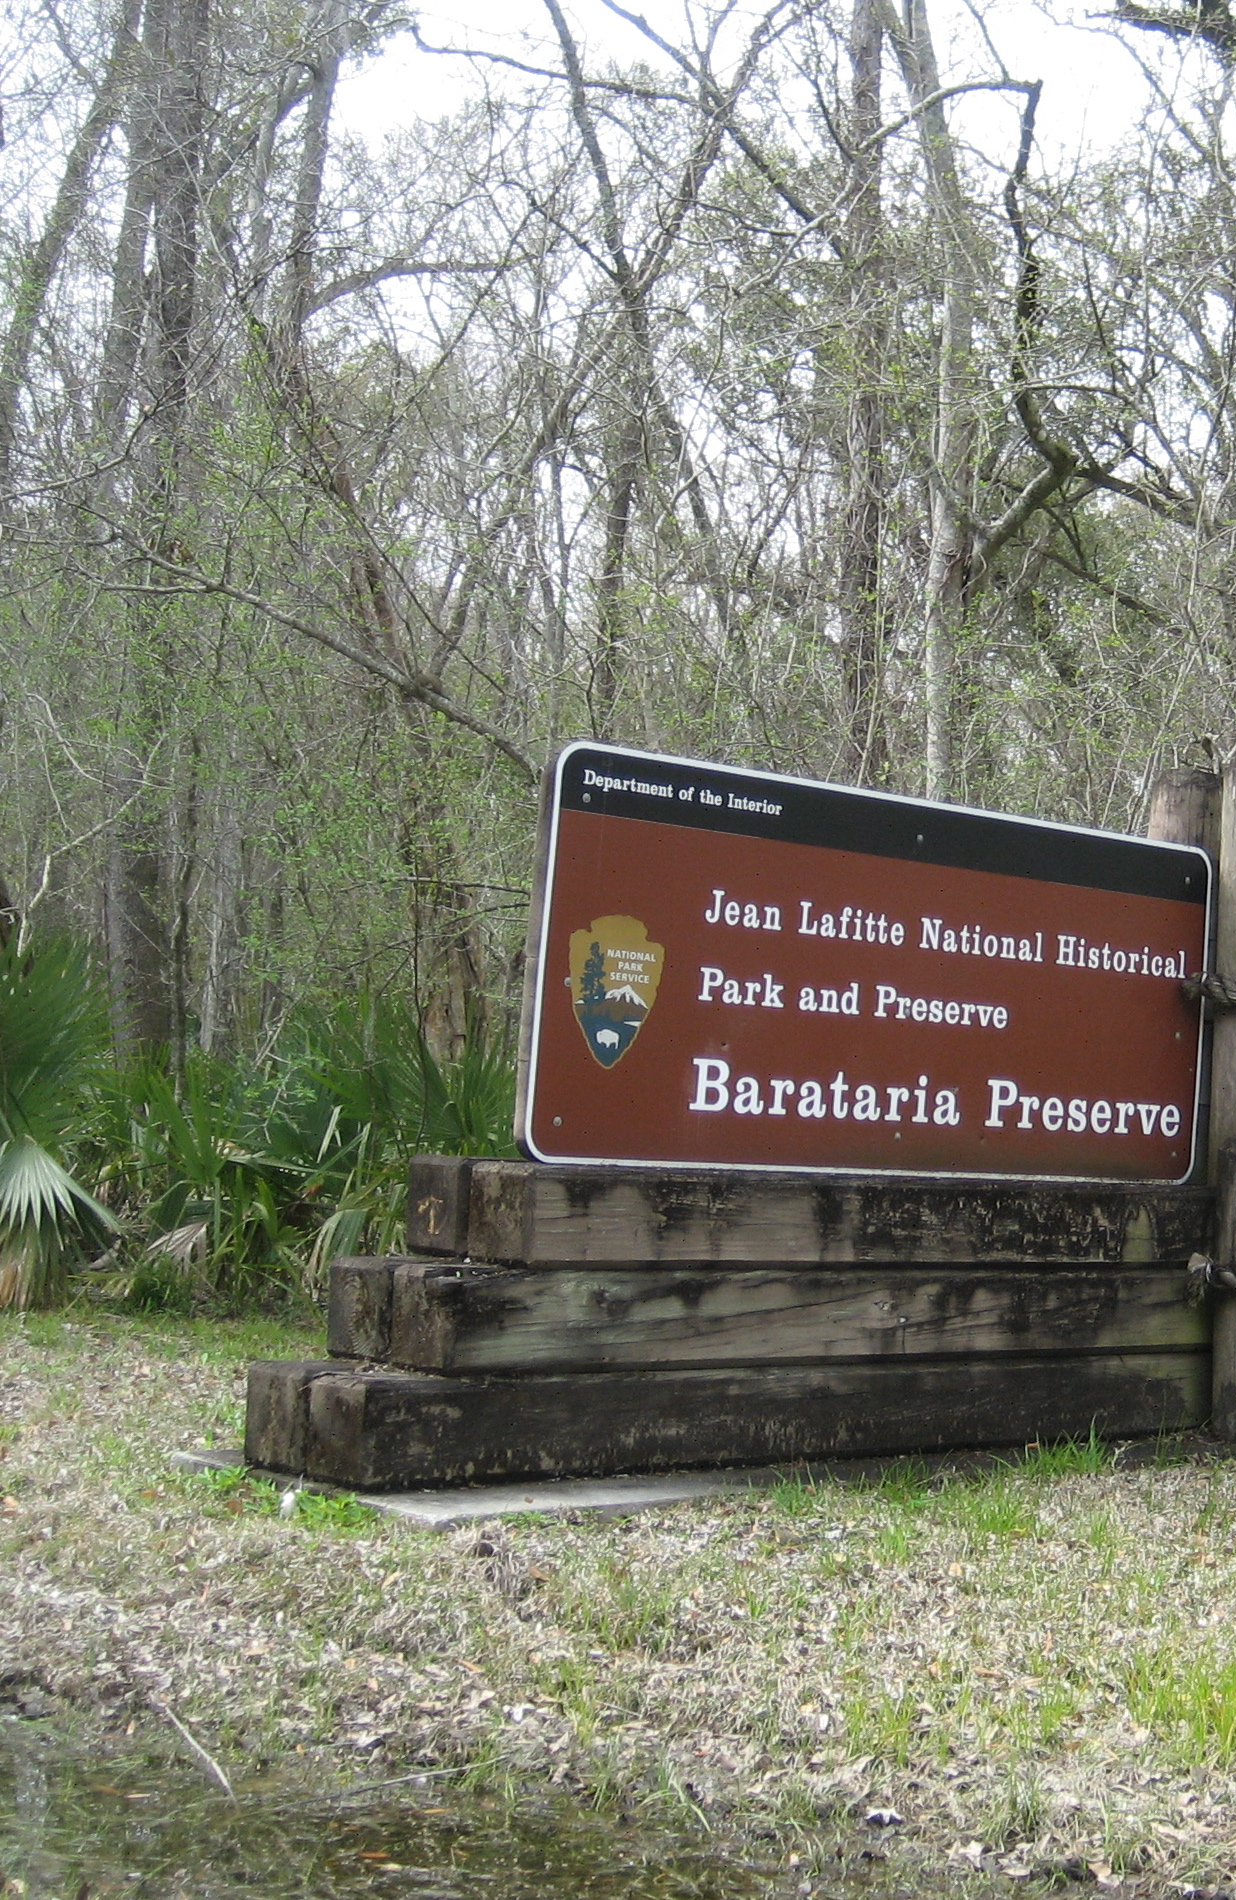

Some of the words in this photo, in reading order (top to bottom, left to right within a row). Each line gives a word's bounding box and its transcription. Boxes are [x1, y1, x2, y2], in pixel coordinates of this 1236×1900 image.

[582, 769, 674, 798] Department
[678, 786, 695, 802] of
[699, 789, 723, 806] the
[727, 793, 783, 816] Interior
[607, 948, 656, 963] NATIONAL
[704, 889, 782, 931] Jean
[797, 900, 905, 946] Lafitte
[919, 917, 1043, 963] National
[1055, 934, 1186, 979] Historical
[609, 971, 650, 984] SERVICE
[617, 961, 643, 972] PARK
[697, 966, 784, 1009] Park
[798, 982, 860, 1015] and
[873, 984, 1008, 1029] Preserve
[688, 1057, 961, 1126] Barataria
[984, 1079, 1180, 1137] Preserve
